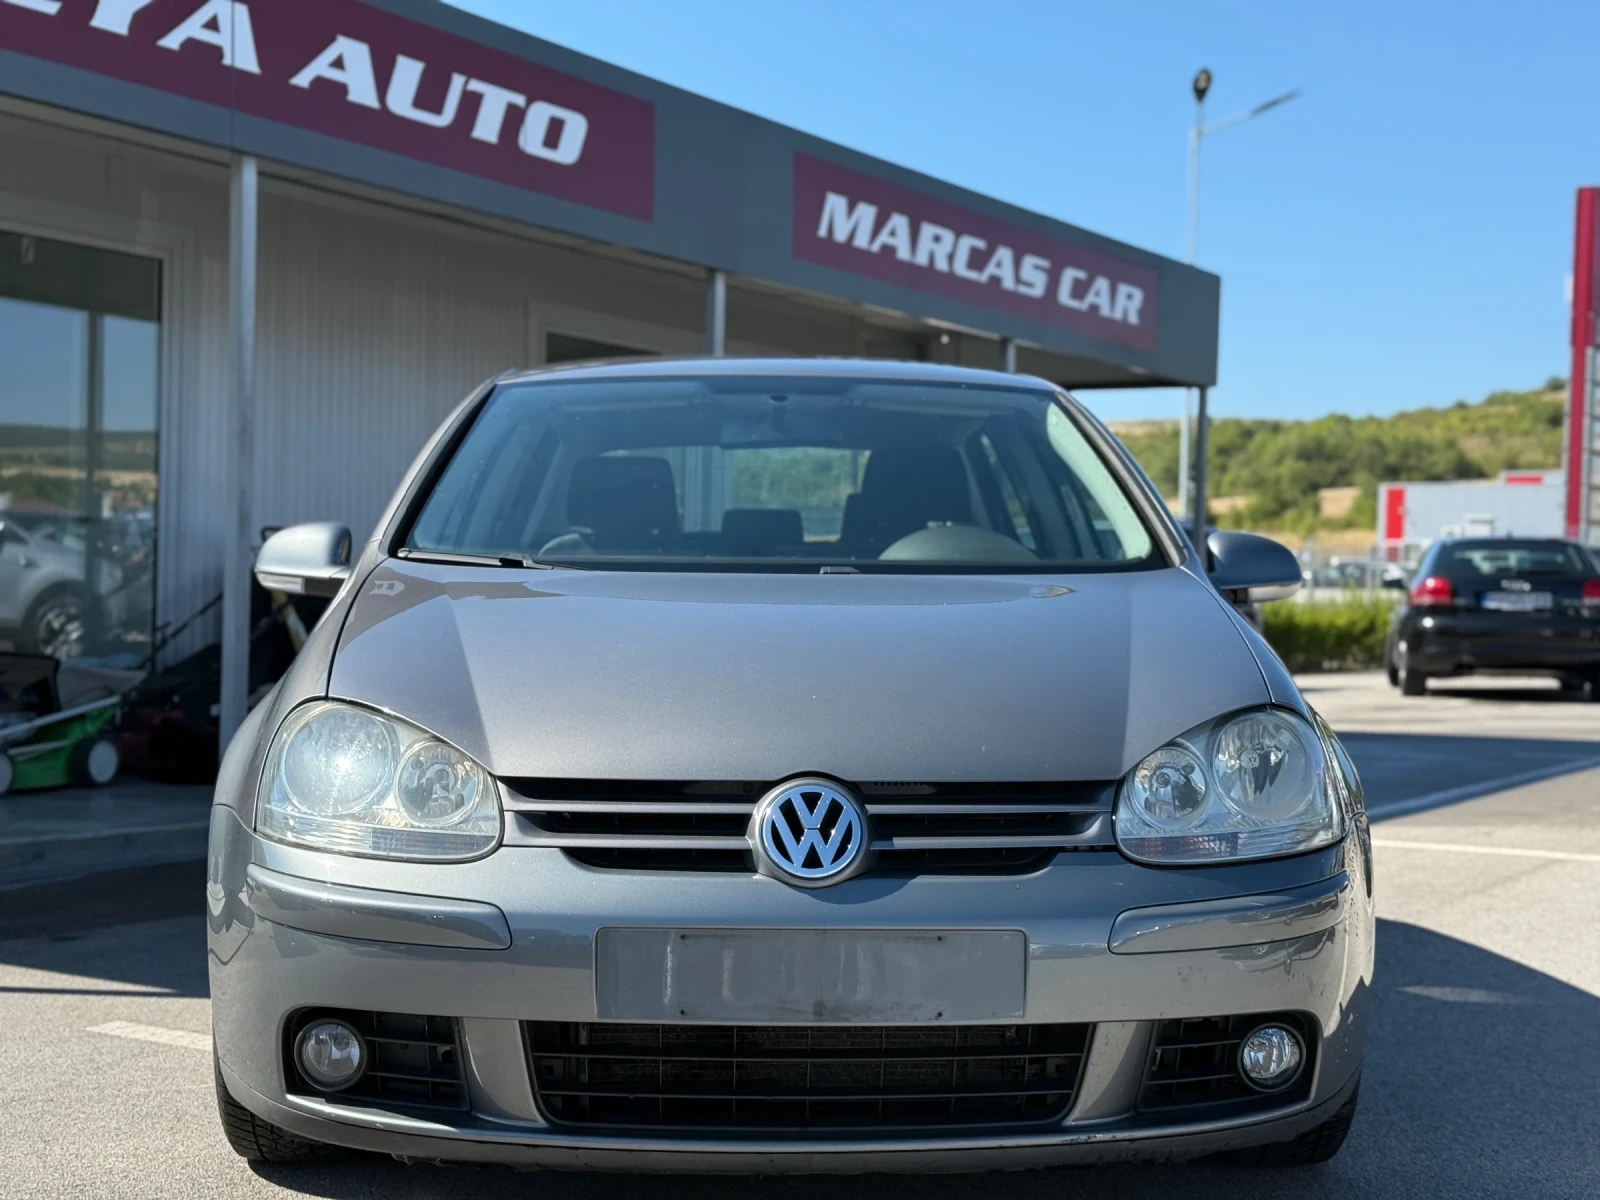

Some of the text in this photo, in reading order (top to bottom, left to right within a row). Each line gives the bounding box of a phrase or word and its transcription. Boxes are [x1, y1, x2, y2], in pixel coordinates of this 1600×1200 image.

[0, 0, 589, 166] YA AUTO
[817, 191, 1144, 326] MARCAS CAR
[763, 785, 861, 878] VW
